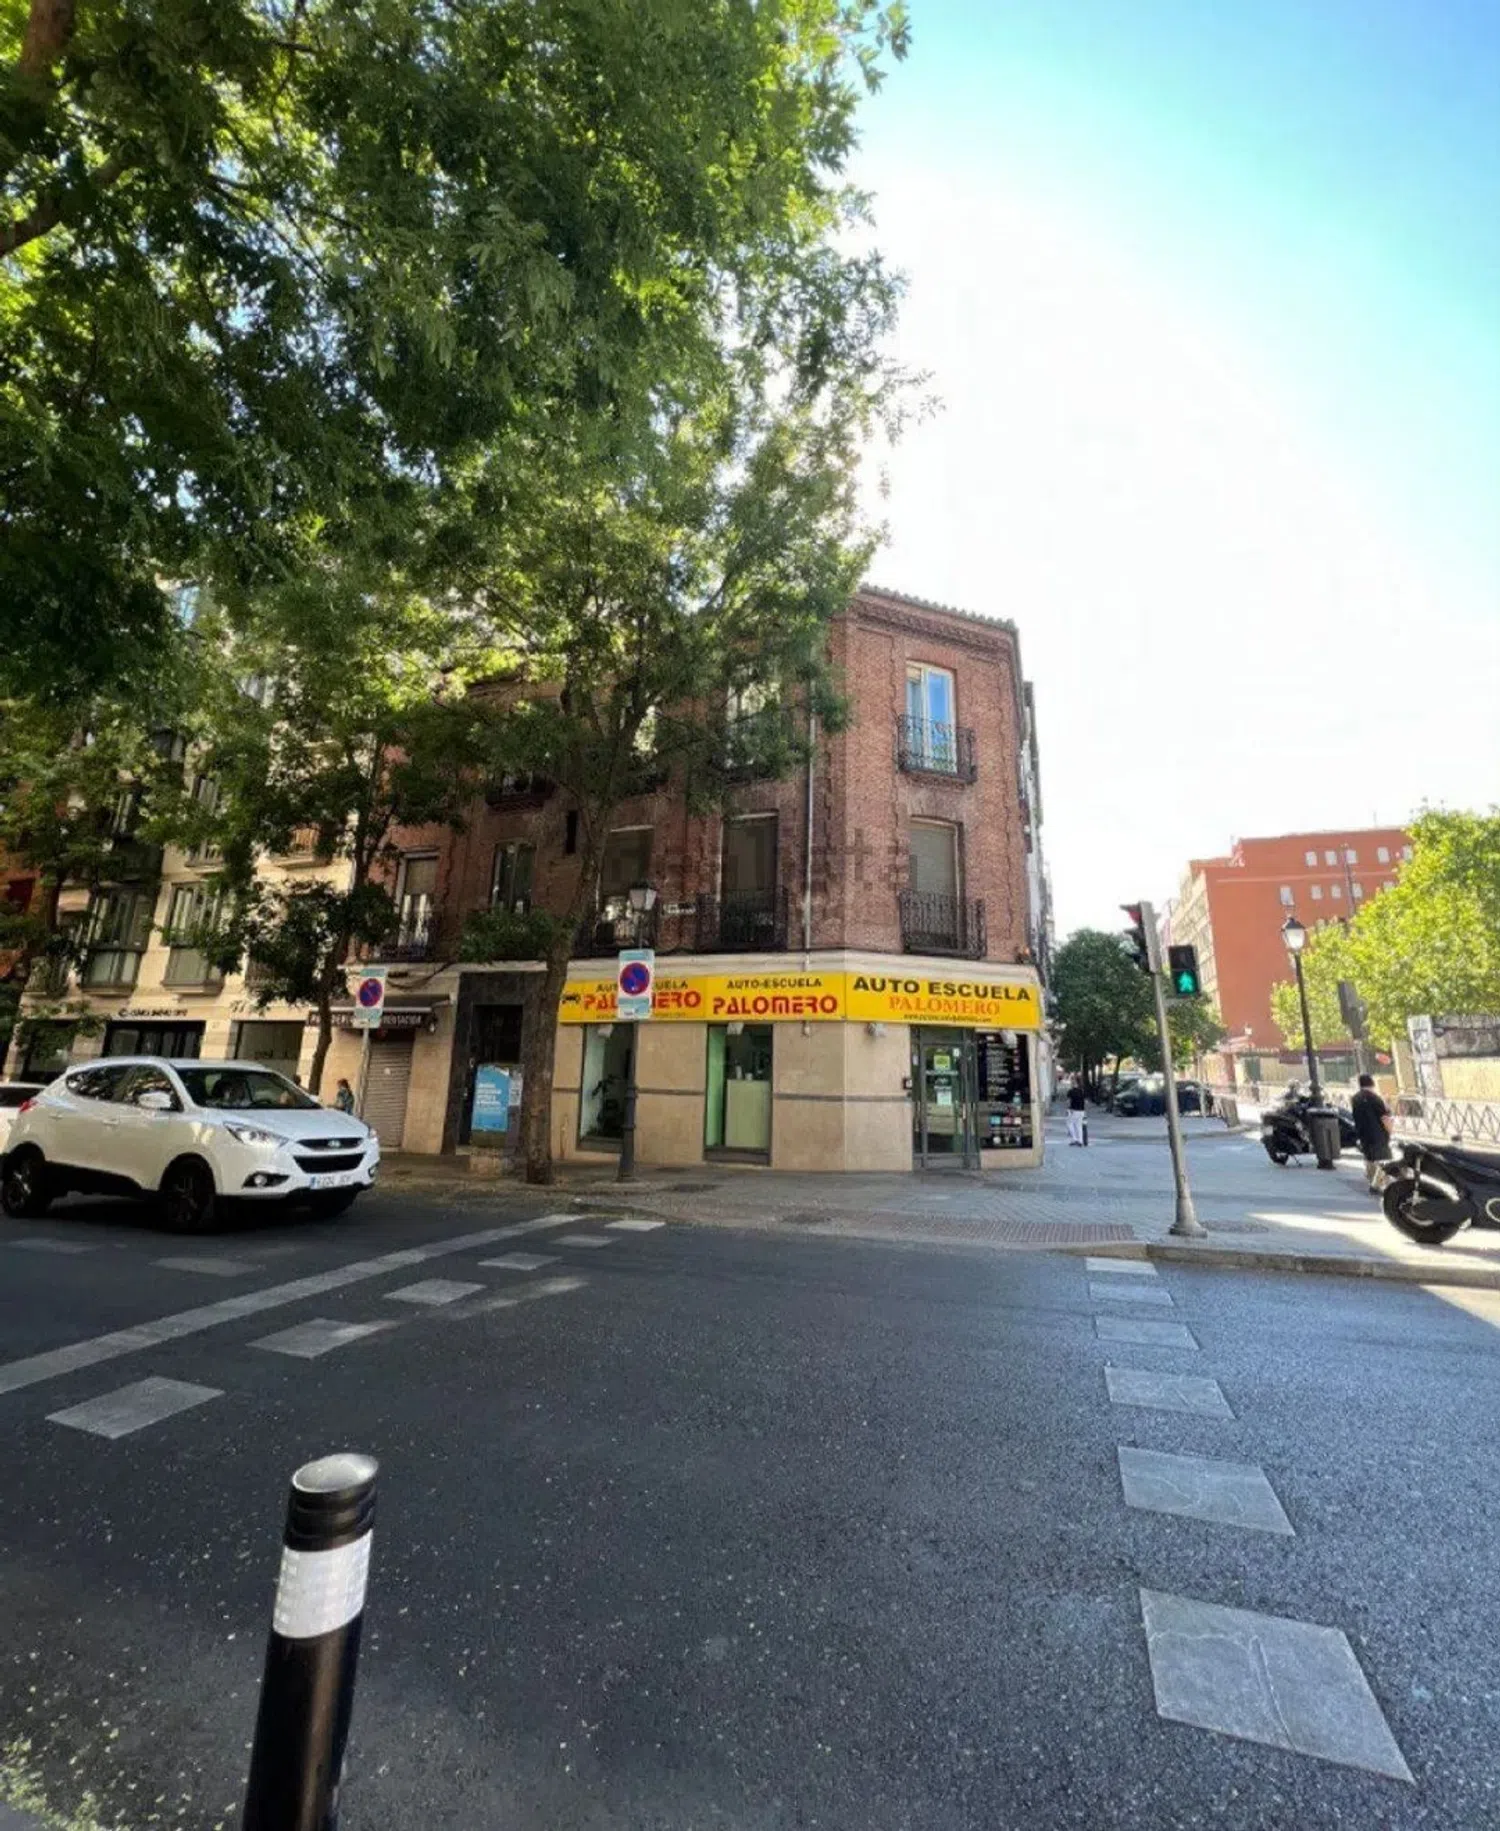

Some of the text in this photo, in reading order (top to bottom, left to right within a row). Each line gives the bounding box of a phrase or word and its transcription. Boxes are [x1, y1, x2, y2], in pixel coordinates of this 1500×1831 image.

[726, 978, 823, 990] AUTO-ESCUELA
[853, 976, 1031, 1001] AUTO ESCUELA
[583, 990, 702, 1011] PALERO
[712, 995, 838, 1015] PALOMERO
[888, 995, 1001, 1015] PALOMERO
